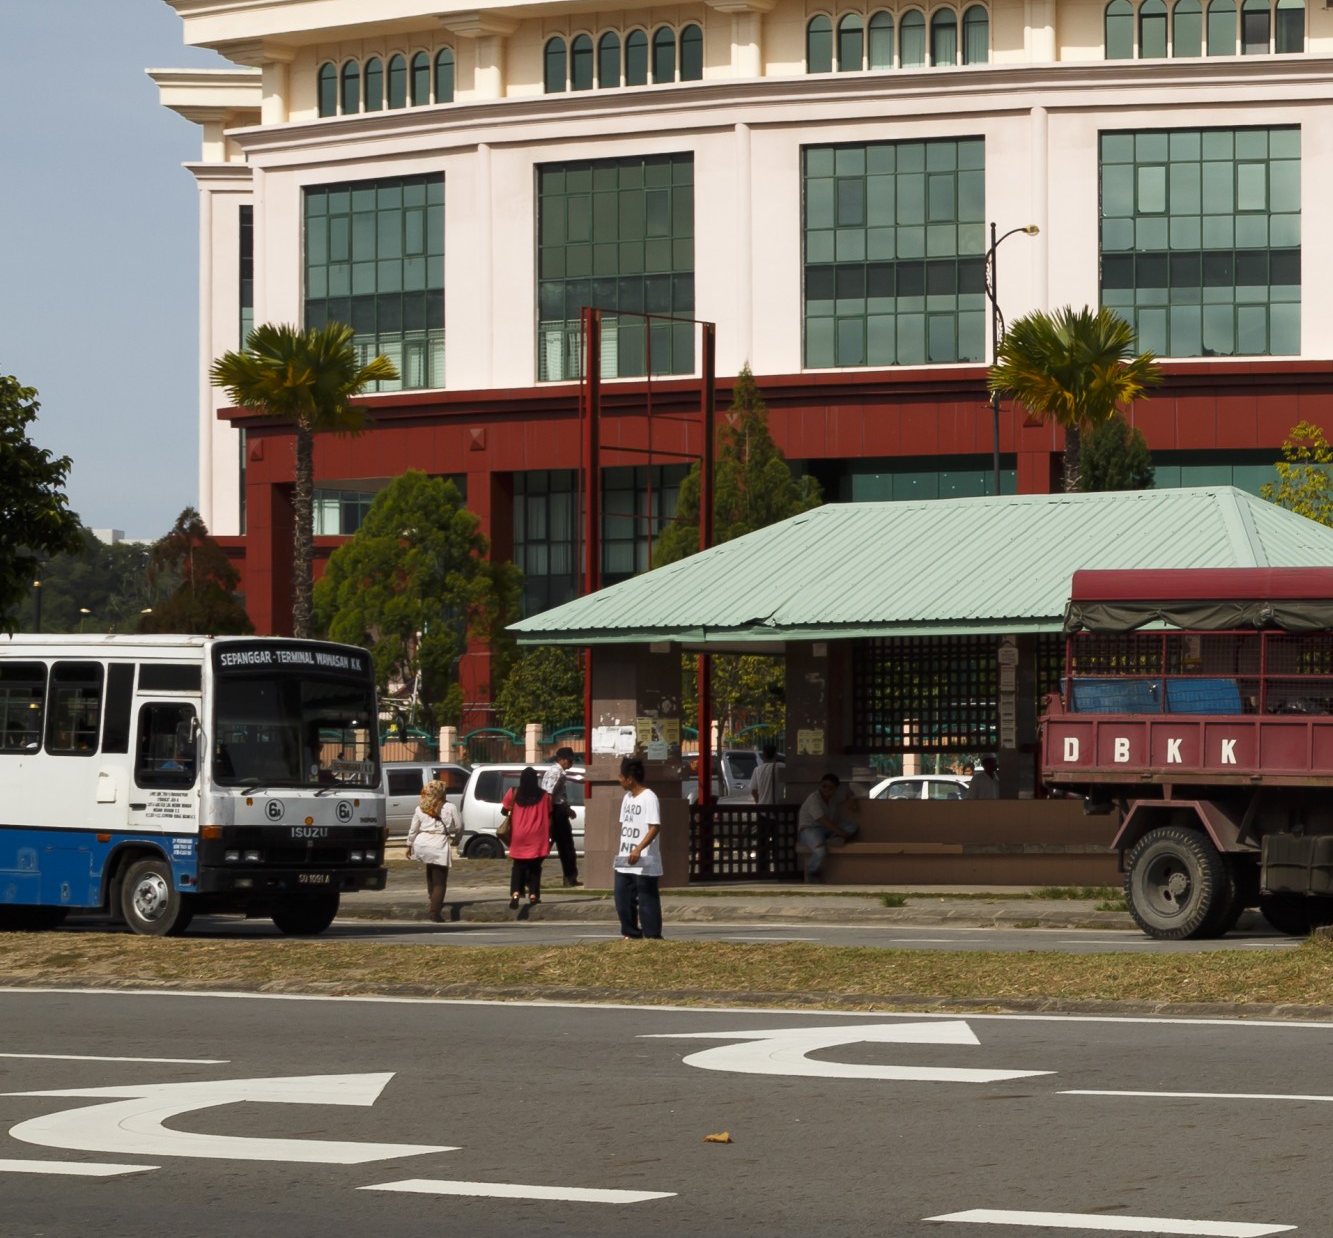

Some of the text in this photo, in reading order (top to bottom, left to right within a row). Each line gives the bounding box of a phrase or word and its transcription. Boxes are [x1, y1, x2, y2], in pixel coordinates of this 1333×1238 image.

[220, 650, 272, 666] SEPANGGAR
[315, 652, 349, 670] WAWASAN
[291, 827, 328, 838] ISUZU
